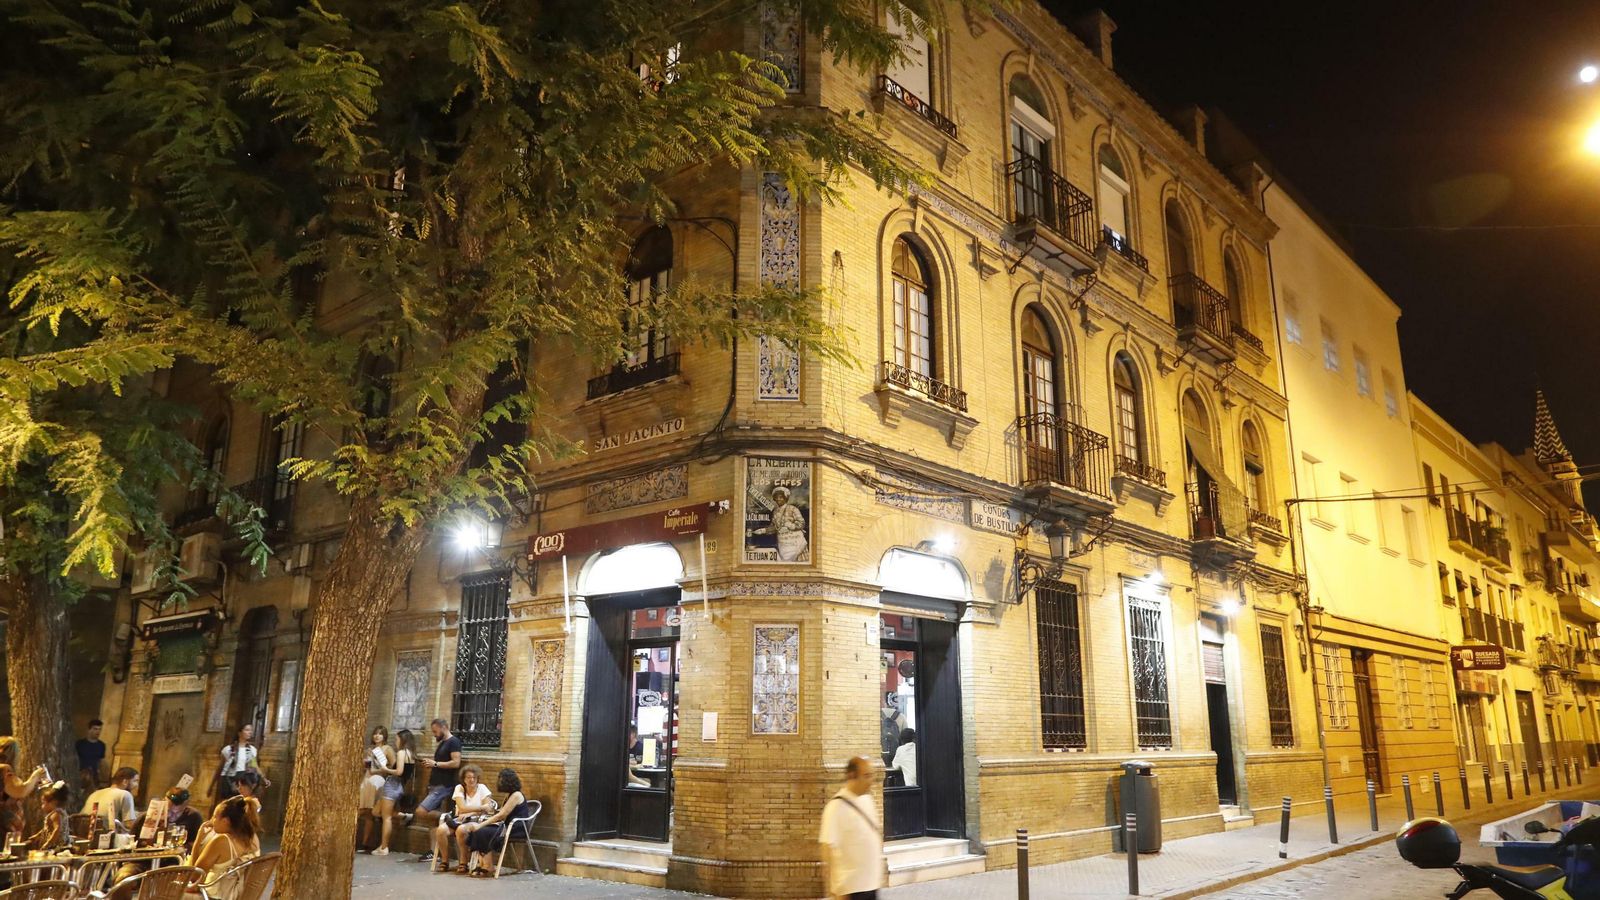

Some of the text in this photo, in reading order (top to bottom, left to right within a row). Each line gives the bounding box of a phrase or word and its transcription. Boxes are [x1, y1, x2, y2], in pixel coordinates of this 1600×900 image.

[595, 418, 682, 449] SAN JACINTO
[749, 458, 761, 467] LA
[982, 503, 1010, 519] CONDES
[664, 511, 699, 530] Imperiale
[974, 512, 984, 525] DE
[540, 534, 559, 548] 100
[746, 551, 777, 562] TETUAN 20
